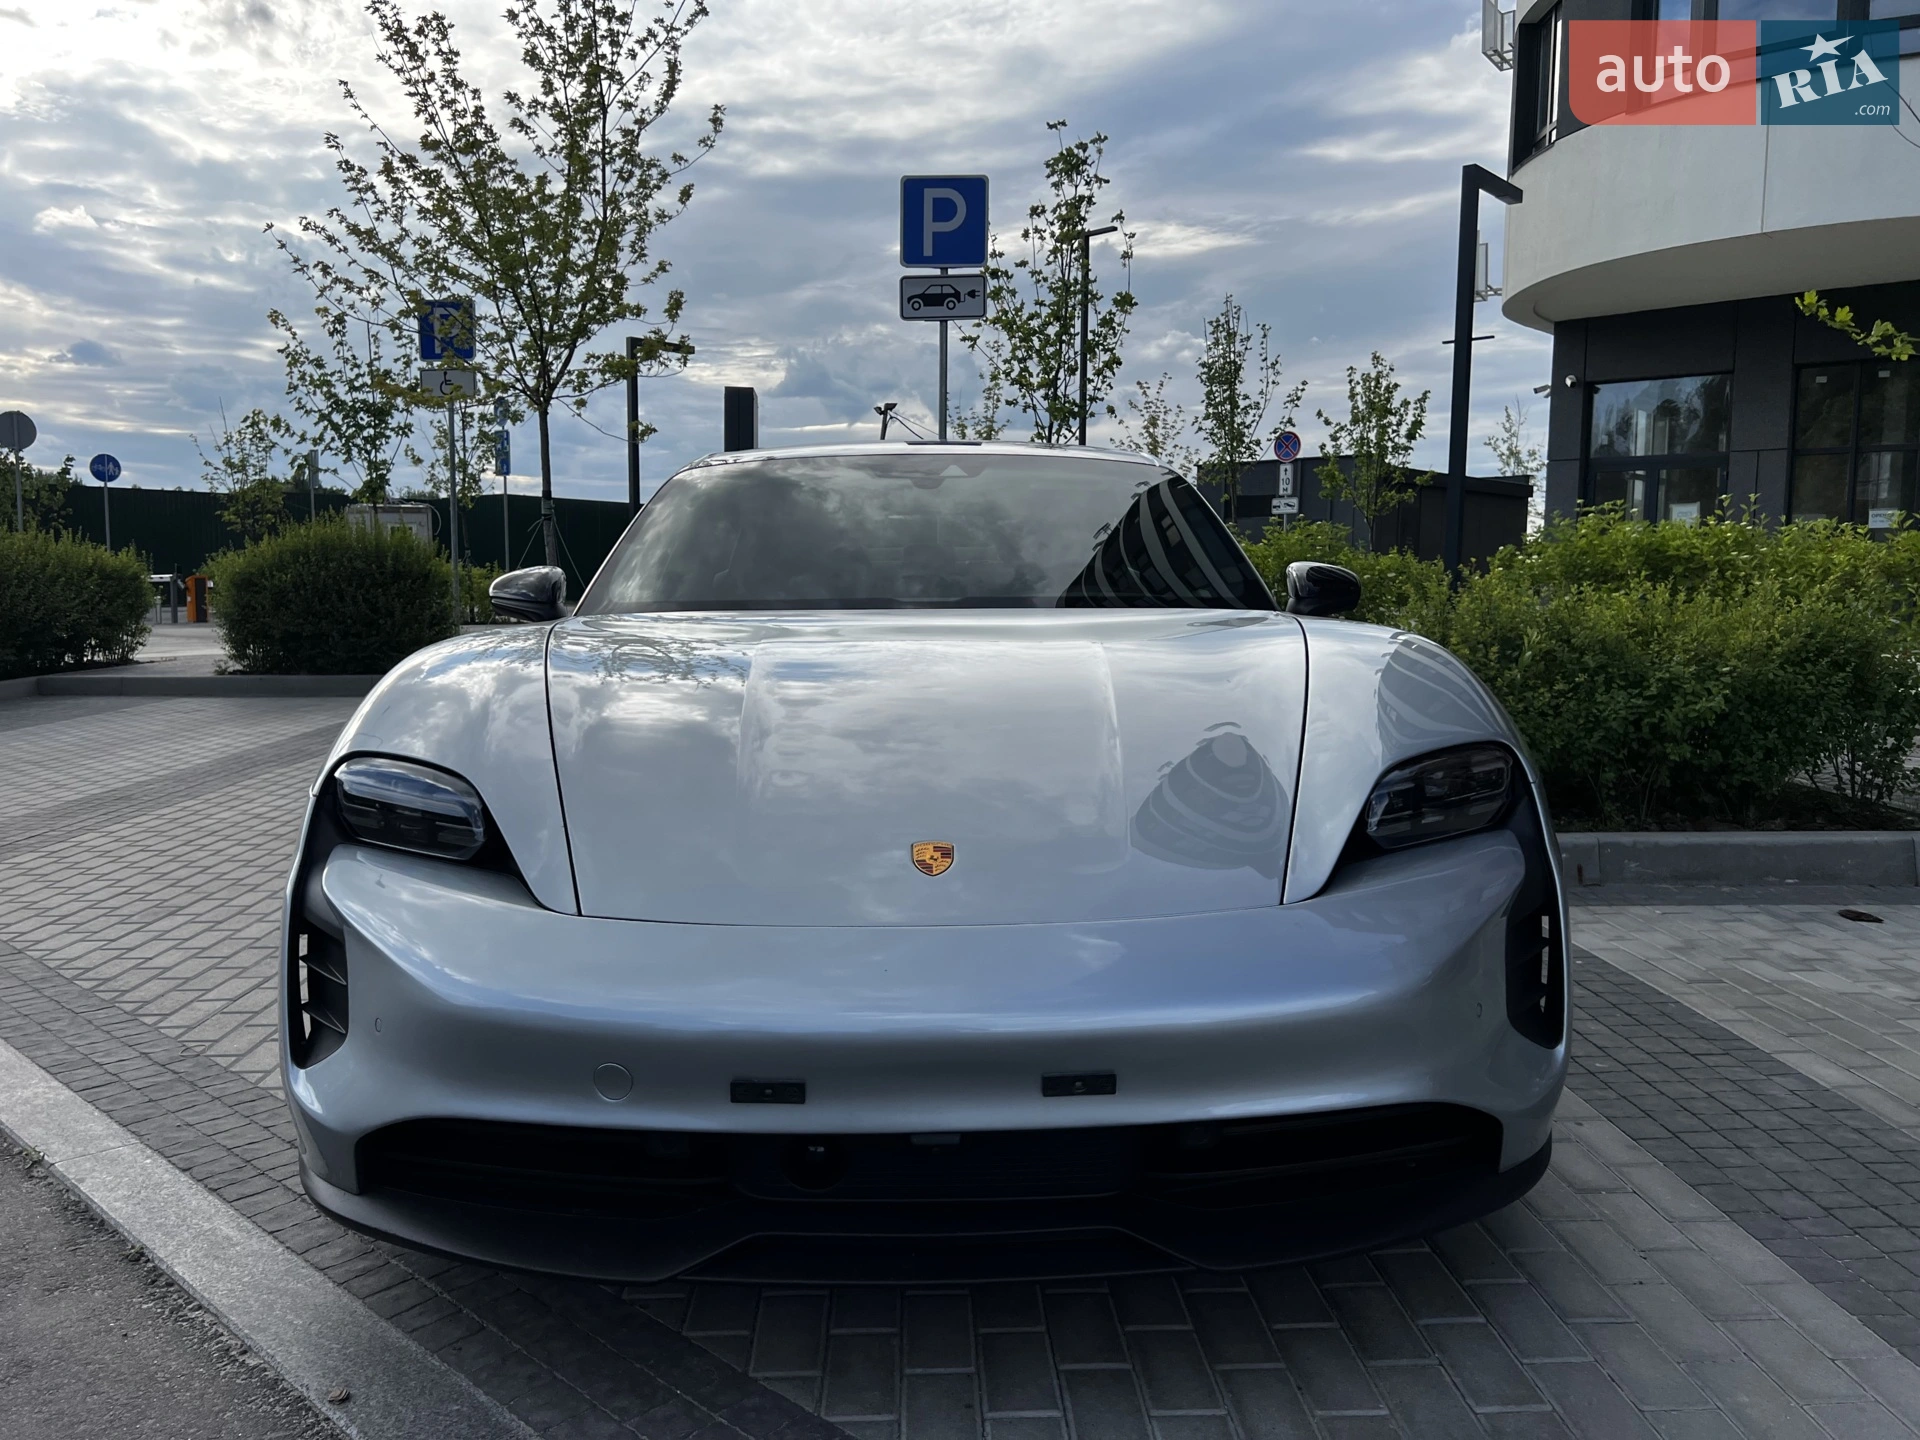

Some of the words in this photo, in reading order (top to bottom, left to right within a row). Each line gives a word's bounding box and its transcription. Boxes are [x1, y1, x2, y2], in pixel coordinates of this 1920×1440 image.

[923, 188, 967, 257] P
[433, 307, 464, 354] P
[1281, 477, 1290, 486] 10
